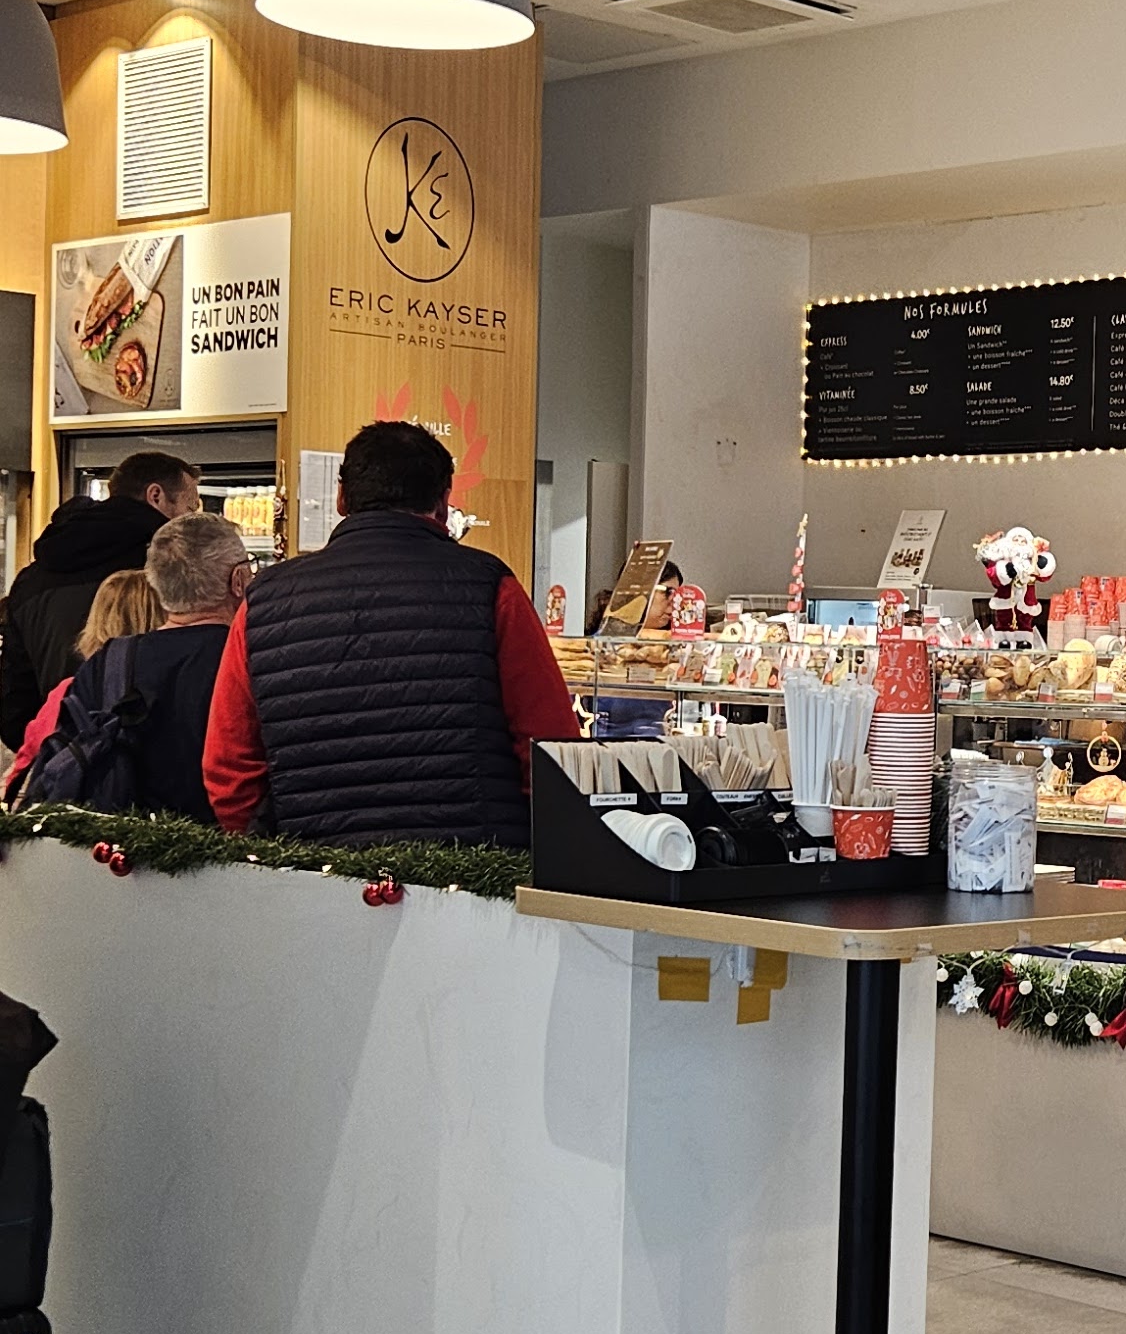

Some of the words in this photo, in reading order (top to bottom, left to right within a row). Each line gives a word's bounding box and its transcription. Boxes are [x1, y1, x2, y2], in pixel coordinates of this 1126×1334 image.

[192, 285, 211, 305] UN
[214, 281, 244, 303] BON
[246, 277, 280, 299] PAIN
[191, 307, 222, 330] FAIT
[225, 304, 246, 326] UN
[249, 301, 280, 323] BON
[329, 287, 395, 314] ERIC
[407, 298, 508, 330] KAYSER
[903, 304, 925, 320] NOS
[929, 298, 988, 319] FORMULES
[191, 326, 278, 355] SANDWICH
[329, 311, 406, 329] ARTISAN
[417, 322, 507, 343] BOULANGER
[967, 324, 1003, 338] SANDWICH
[397, 333, 447, 350] PARIS
[820, 336, 848, 348] EXPRESS
